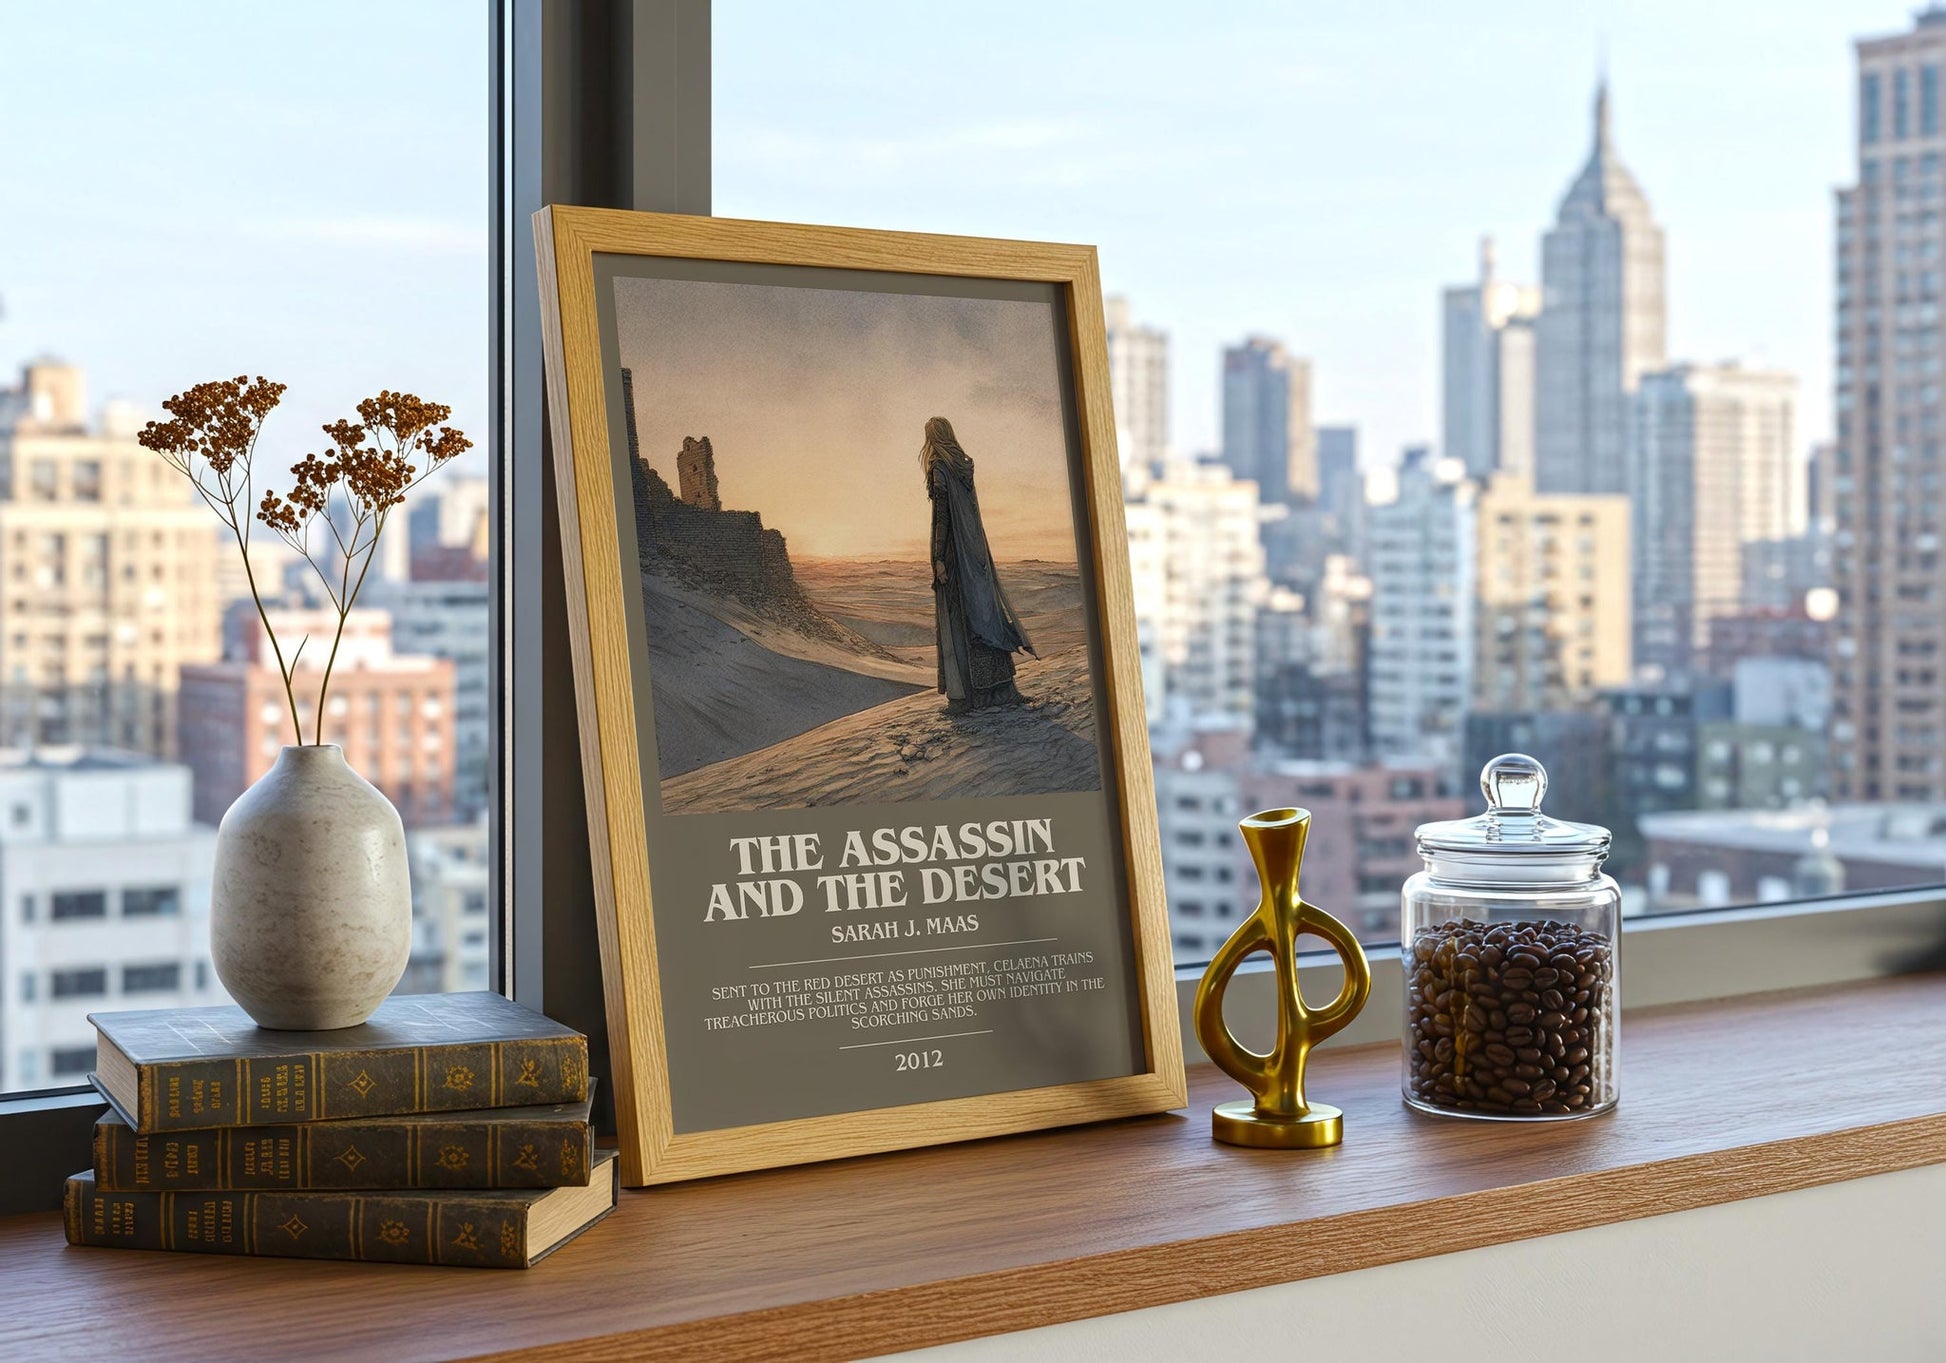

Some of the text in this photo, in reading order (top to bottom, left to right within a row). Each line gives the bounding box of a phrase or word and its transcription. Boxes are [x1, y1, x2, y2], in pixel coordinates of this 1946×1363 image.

[730, 818, 1056, 876] THE ASSASSIN
[703, 857, 1087, 923] AND THE DESERT
[831, 914, 980, 944] SARAH J. MAAS
[711, 951, 1094, 1001] SENT TO THE RED DESERT AS PUNISHMENT, CELAENA TRAINS
[748, 967, 1066, 1012] WITH THE SILENT ASSASSINS. SHE MUST NAVIGATE
[704, 977, 1105, 1031] TREACHEROUS POLITICS AND FORGE HER OWN IDENTITY IN THE
[851, 1004, 978, 1030] SCORCHING SANDS.
[895, 1049, 944, 1072] 2012
